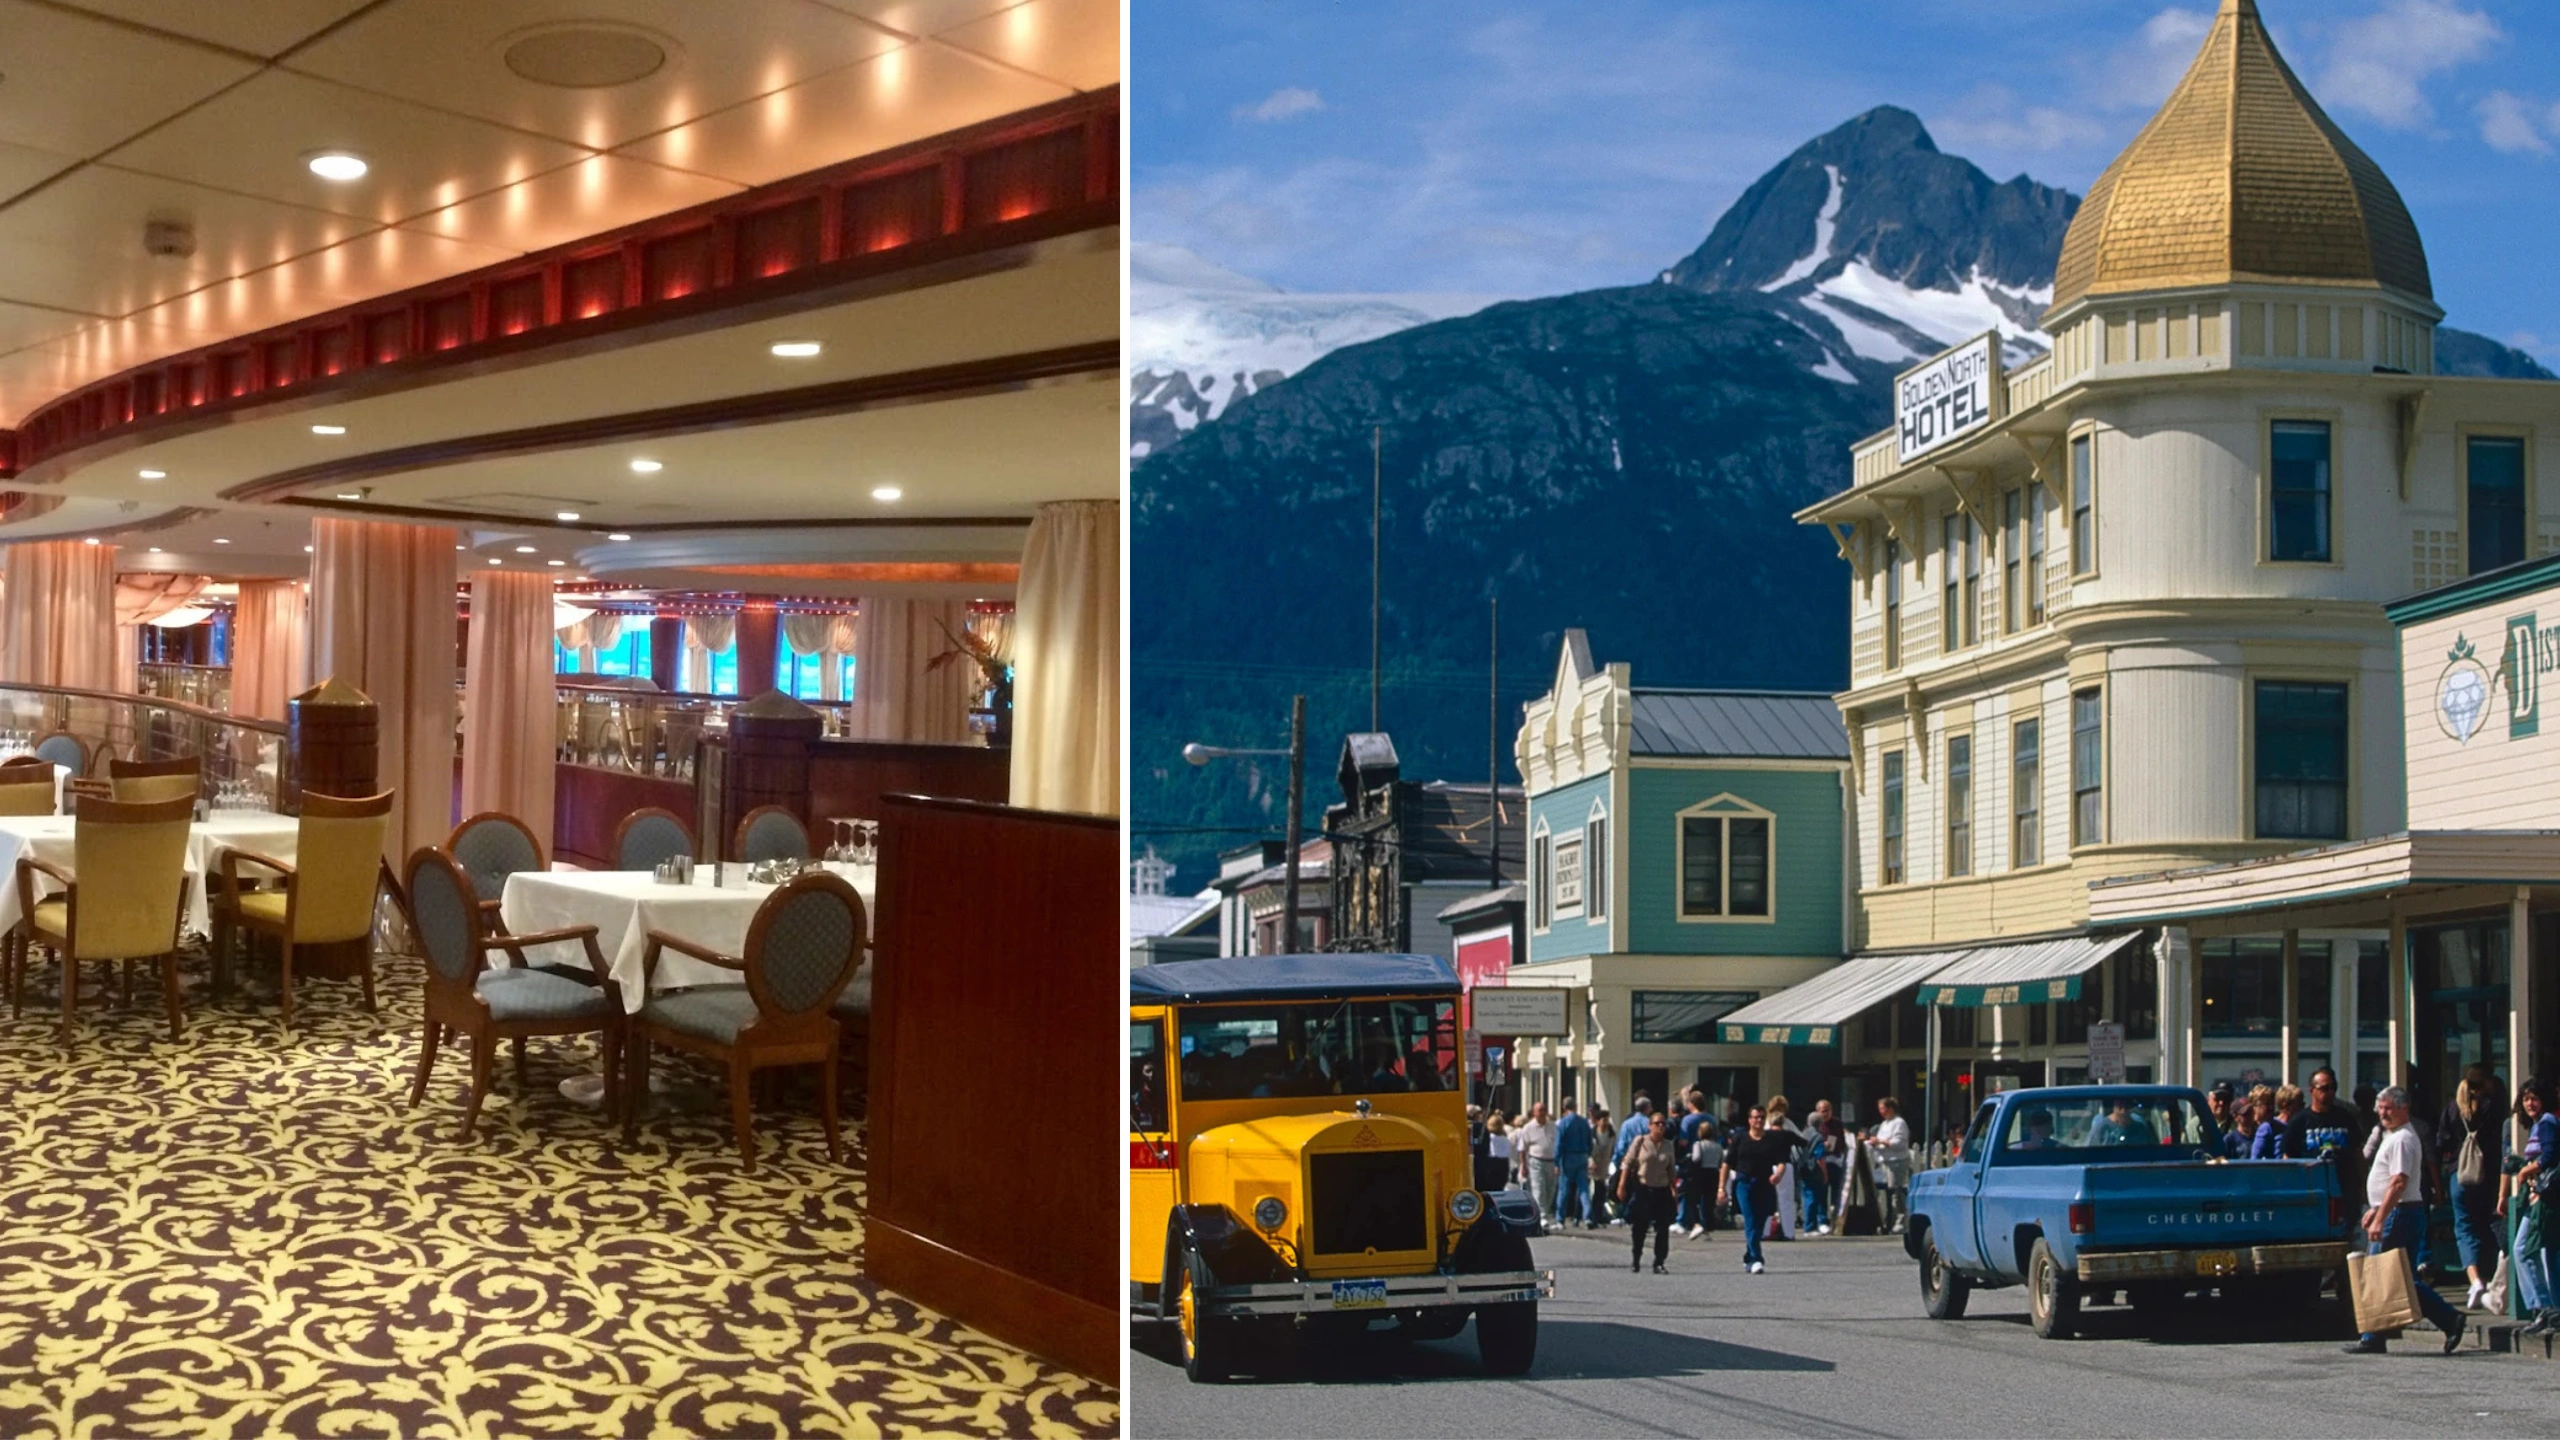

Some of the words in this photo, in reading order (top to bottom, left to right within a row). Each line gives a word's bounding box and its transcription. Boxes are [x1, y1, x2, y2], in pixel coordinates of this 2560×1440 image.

[1902, 366, 1947, 412] GOLDEN
[1947, 347, 1987, 386] NORTH
[1900, 381, 1988, 453] HOTEL
[2147, 1211, 2275, 1225] CHEVROLET
